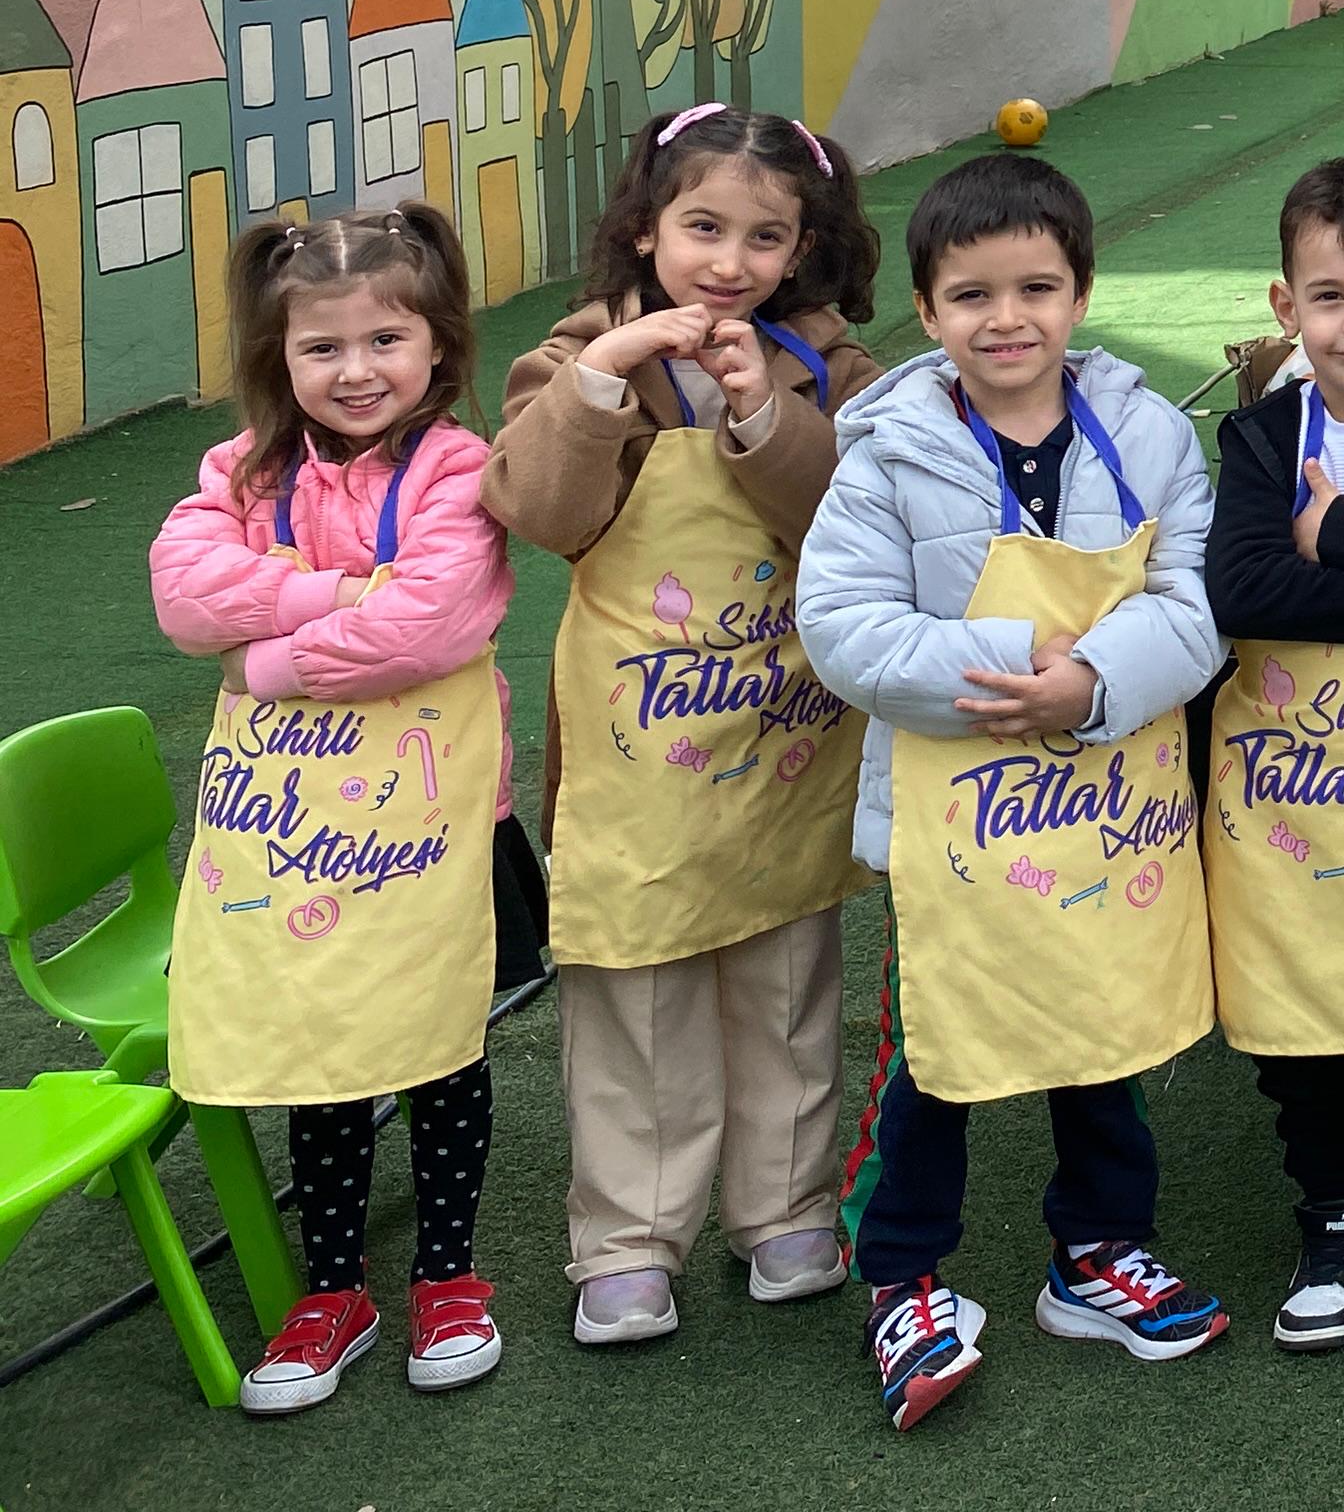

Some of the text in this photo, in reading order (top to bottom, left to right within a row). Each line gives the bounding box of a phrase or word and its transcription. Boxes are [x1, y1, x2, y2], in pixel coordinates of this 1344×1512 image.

[237, 701, 366, 759] Sihirli
[616, 645, 796, 730] Tatlar
[202, 747, 309, 839] Tatlar
[950, 750, 1134, 850] Tatlar
[267, 824, 449, 894] Atölyesi
